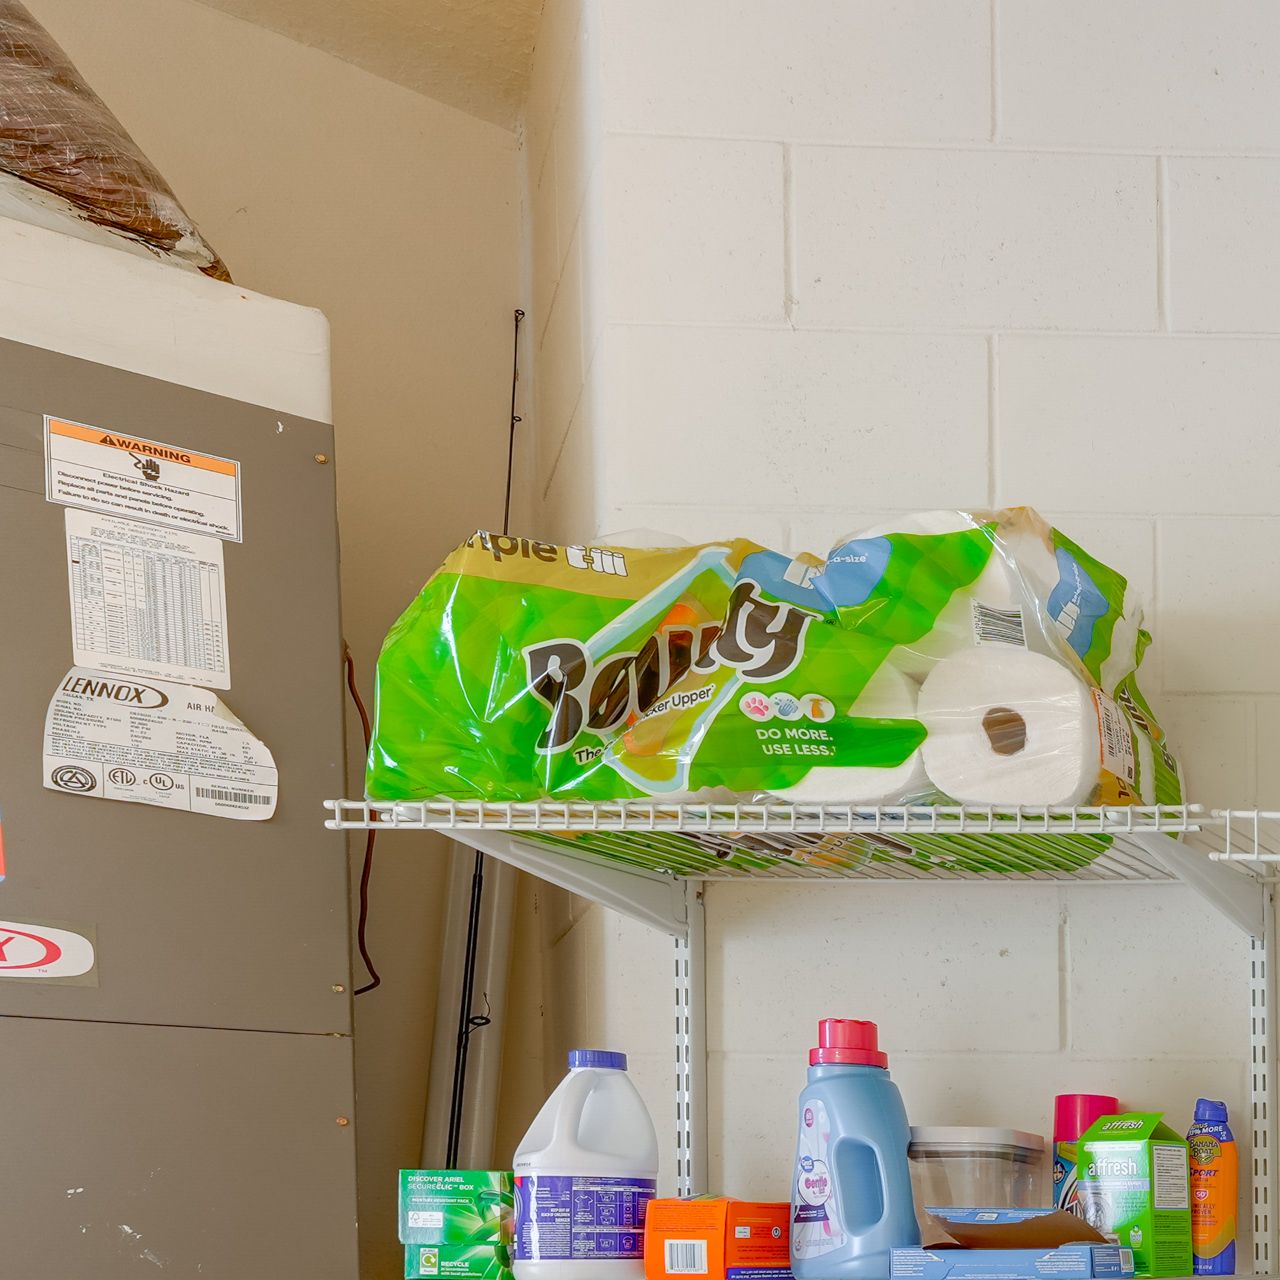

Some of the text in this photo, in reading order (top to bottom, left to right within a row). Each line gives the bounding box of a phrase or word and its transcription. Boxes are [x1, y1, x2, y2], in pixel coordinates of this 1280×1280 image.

[116, 438, 191, 463] WARNING
[57, 471, 173, 501] Disconnect power before servicing.
[103, 473, 190, 496] Electrical Shock Hazard
[62, 676, 148, 704] LENNOX
[186, 702, 201, 712] AIR
[756, 727, 833, 741] DO MORE.
[575, 748, 602, 765] The
[762, 744, 788, 756] USE
[1102, 1120, 1144, 1130] affresh
[1193, 1148, 1213, 1157] BOAT
[1088, 1158, 1137, 1176] affresh
